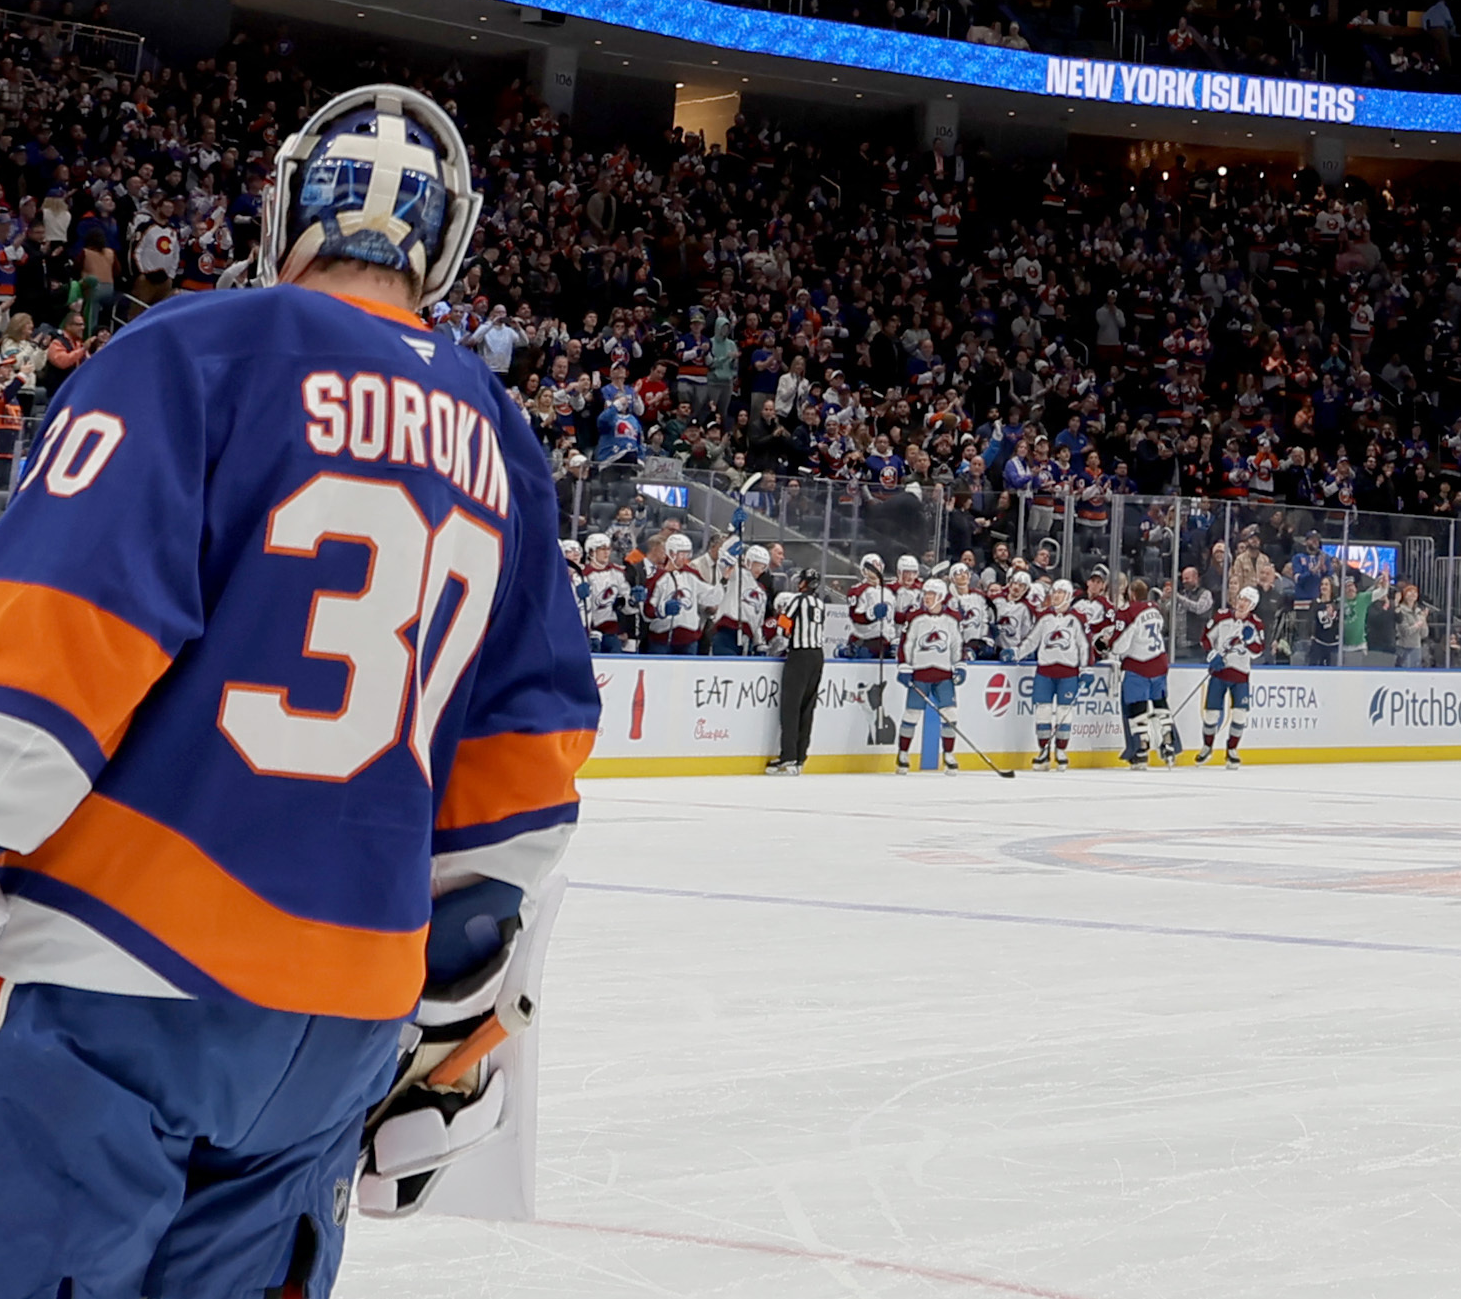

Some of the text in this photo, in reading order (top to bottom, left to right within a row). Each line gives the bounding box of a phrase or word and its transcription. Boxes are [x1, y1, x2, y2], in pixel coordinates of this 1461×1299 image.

[1045, 54, 1355, 123] NEW YORK ISLANDERS
[302, 373, 511, 515] SOROKIN
[218, 471, 504, 789] 30
[695, 676, 733, 708] EAT
